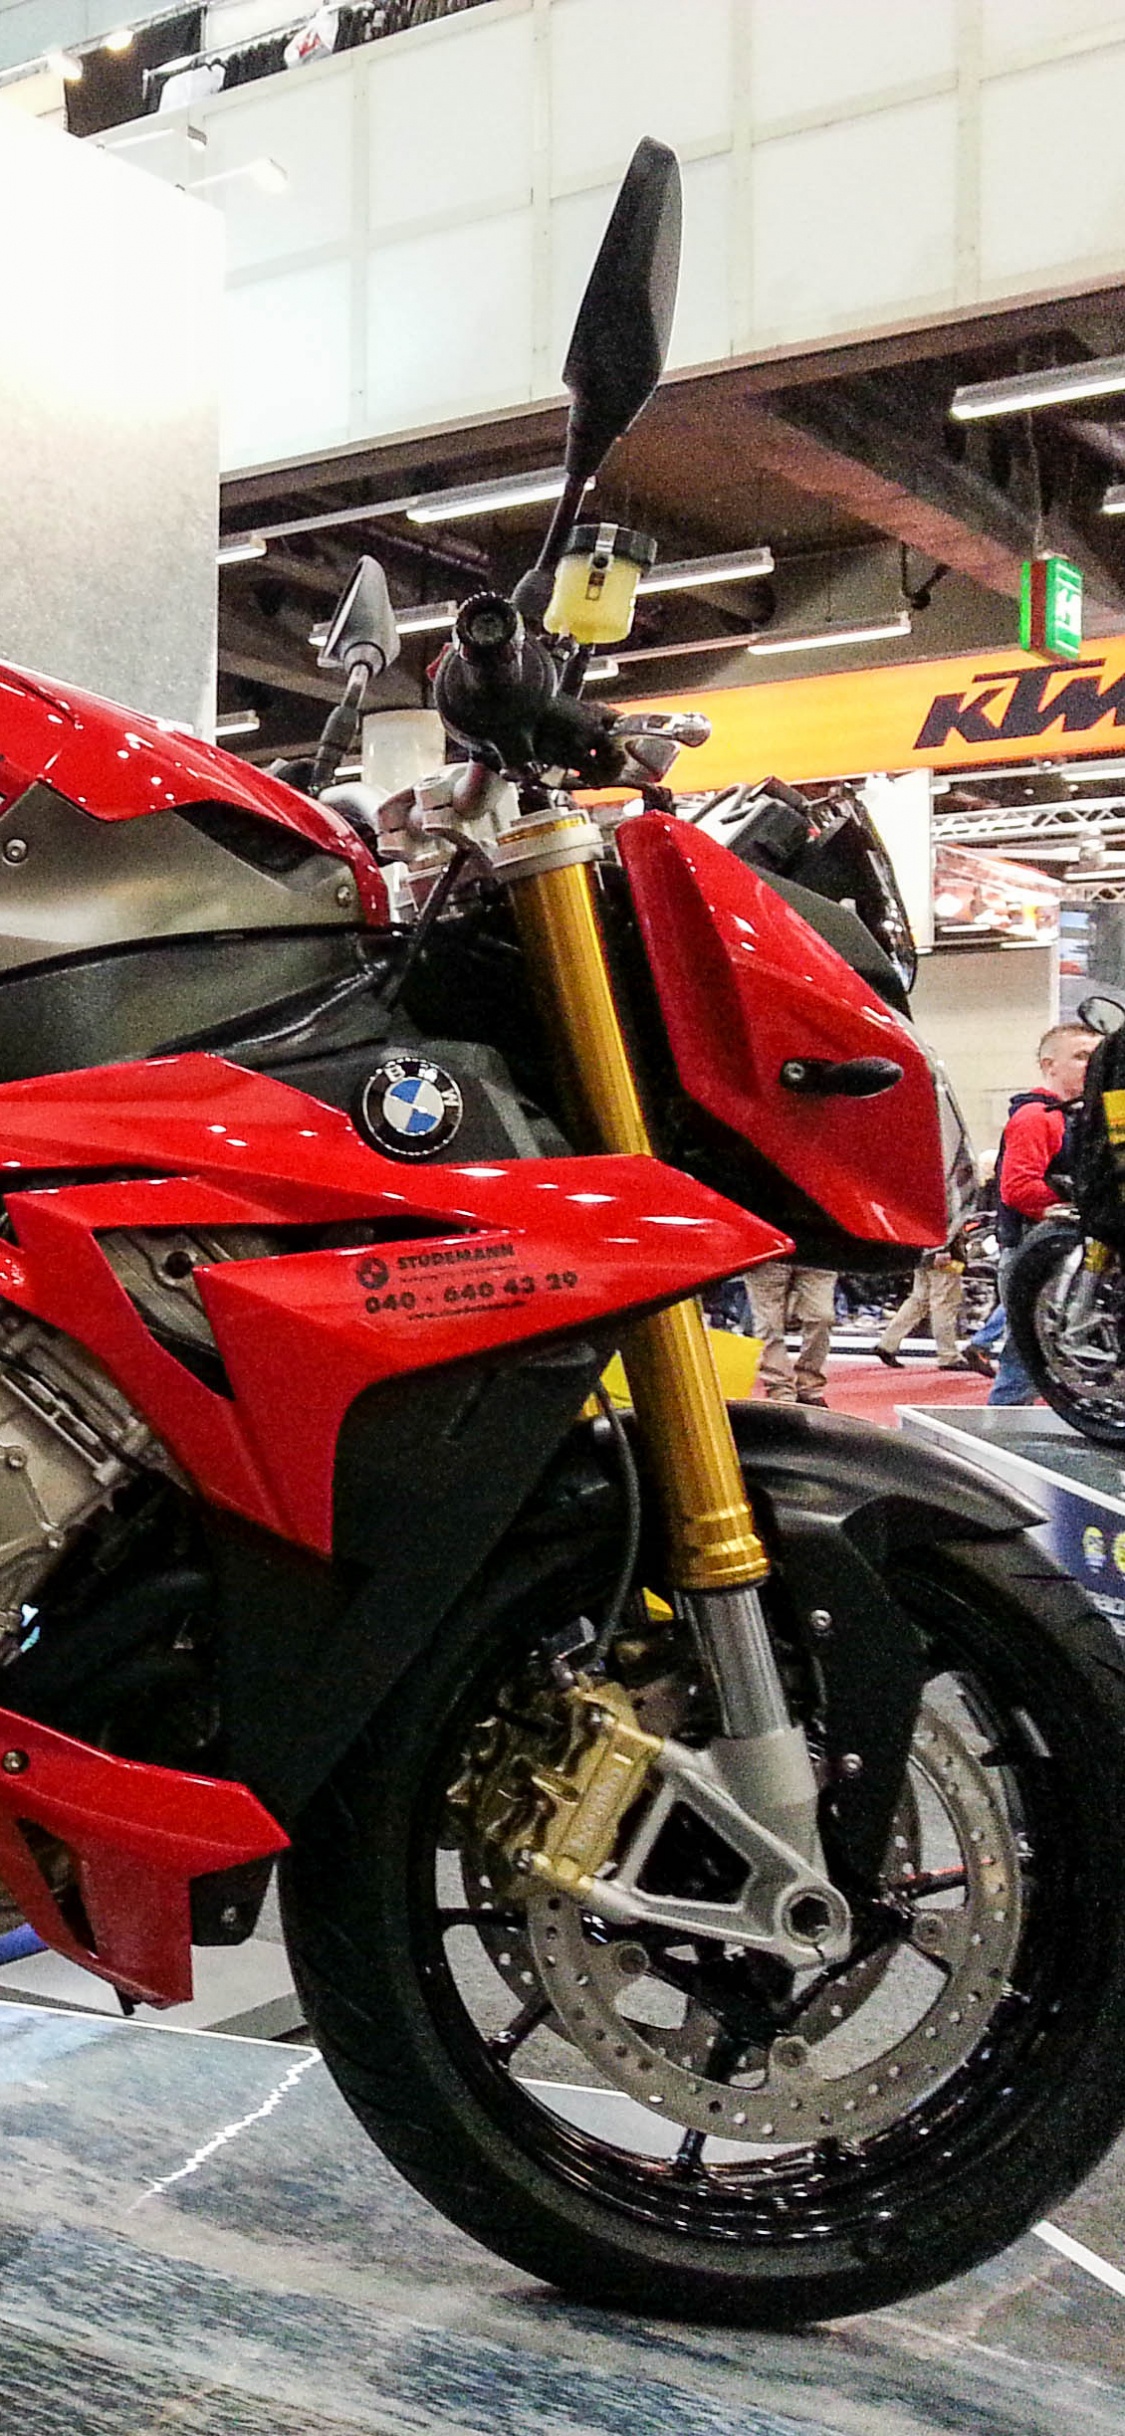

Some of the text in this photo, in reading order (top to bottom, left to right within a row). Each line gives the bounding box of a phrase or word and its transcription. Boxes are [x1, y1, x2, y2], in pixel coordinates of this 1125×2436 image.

[913, 657, 1125, 750] KTM
[384, 1062, 460, 1107] BMW
[365, 1291, 416, 1314] 040
[443, 1281, 495, 1303] 640
[503, 1275, 536, 1295] 43
[545, 1270, 578, 1290] 29
